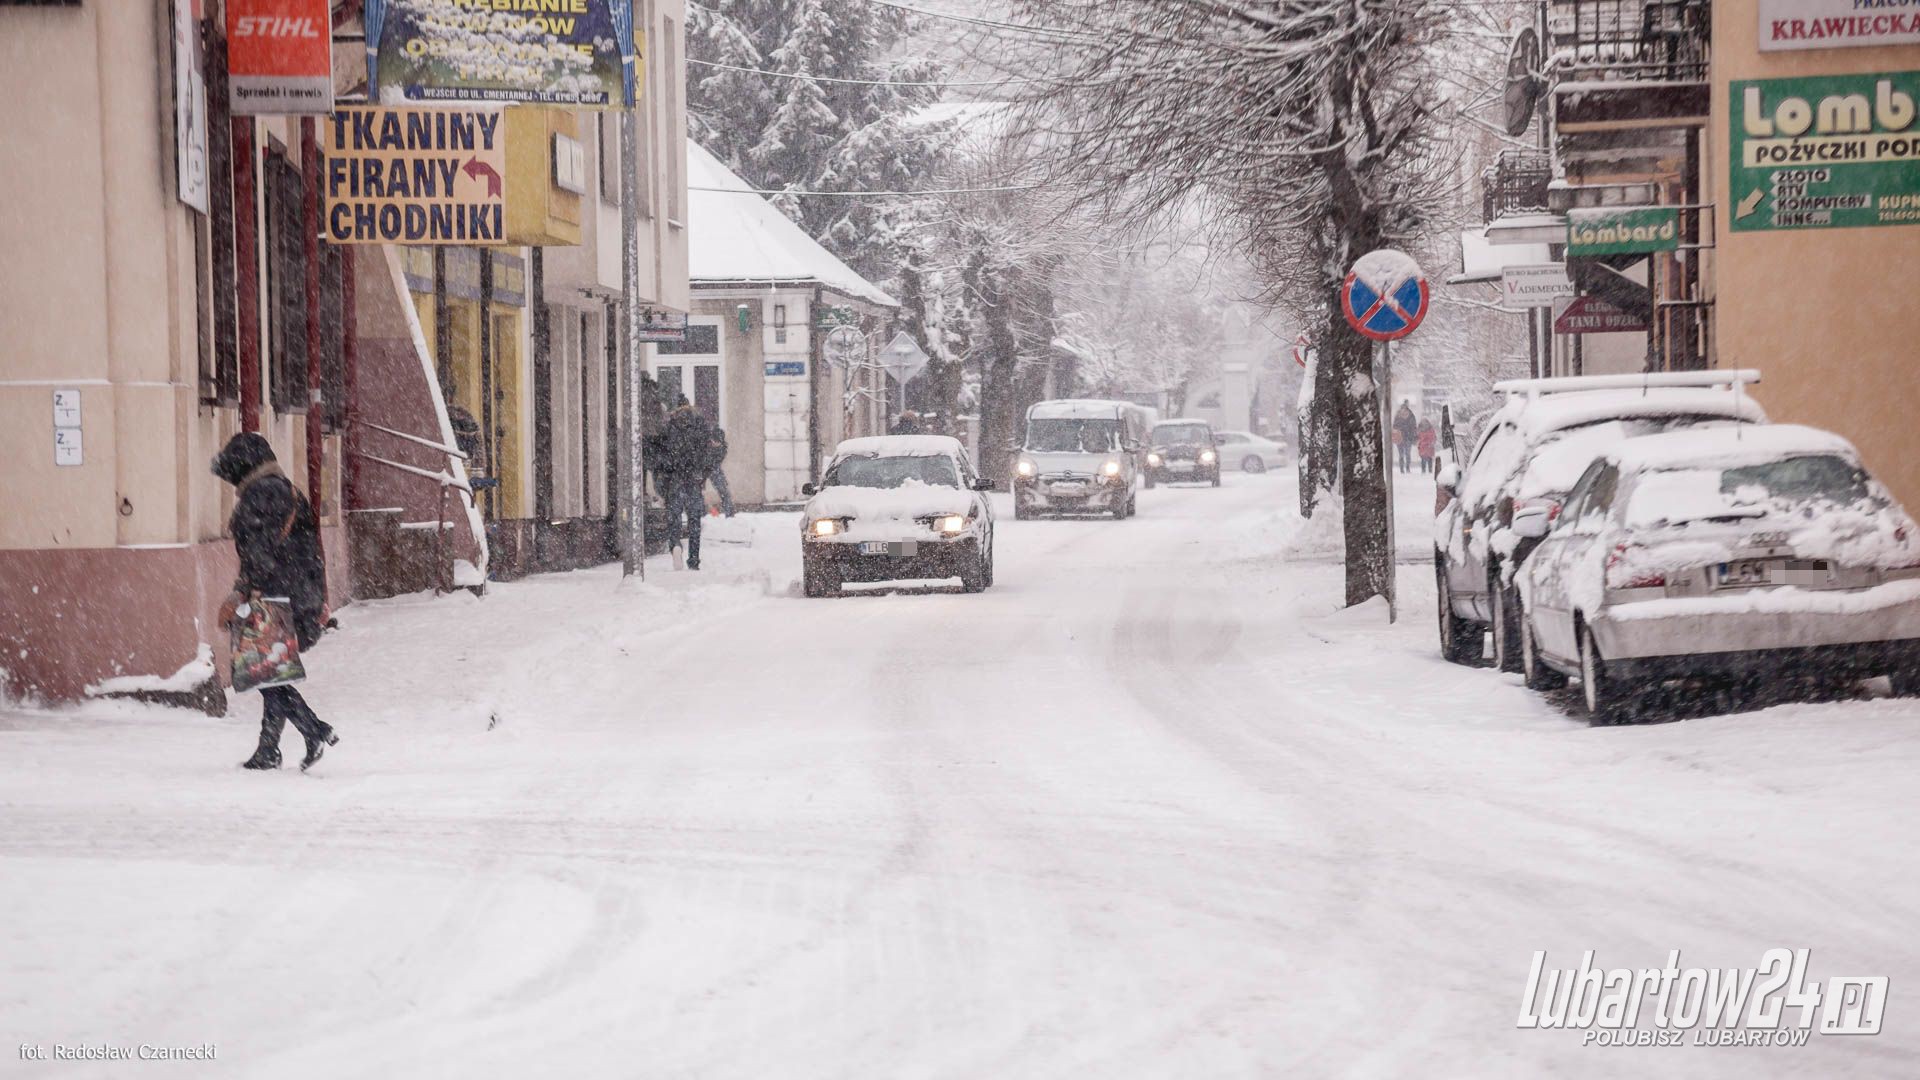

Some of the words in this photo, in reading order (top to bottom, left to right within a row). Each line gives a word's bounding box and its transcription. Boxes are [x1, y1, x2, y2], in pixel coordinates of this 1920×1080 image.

[235, 16, 319, 37] STIHL
[483, 90, 533, 100] CMENTARNEJ
[331, 111, 499, 150] TKANINY
[1756, 138, 1866, 163] POŻYCZKI
[329, 158, 460, 198] FIRANY
[1777, 170, 1827, 183] ZŁOTO
[1777, 185, 1803, 197] RTV
[1777, 195, 1866, 210] KOMPUTERY
[330, 203, 502, 240] CHODNIKI
[1569, 220, 1674, 245] Lombard
[1568, 315, 1601, 328] TANIA
